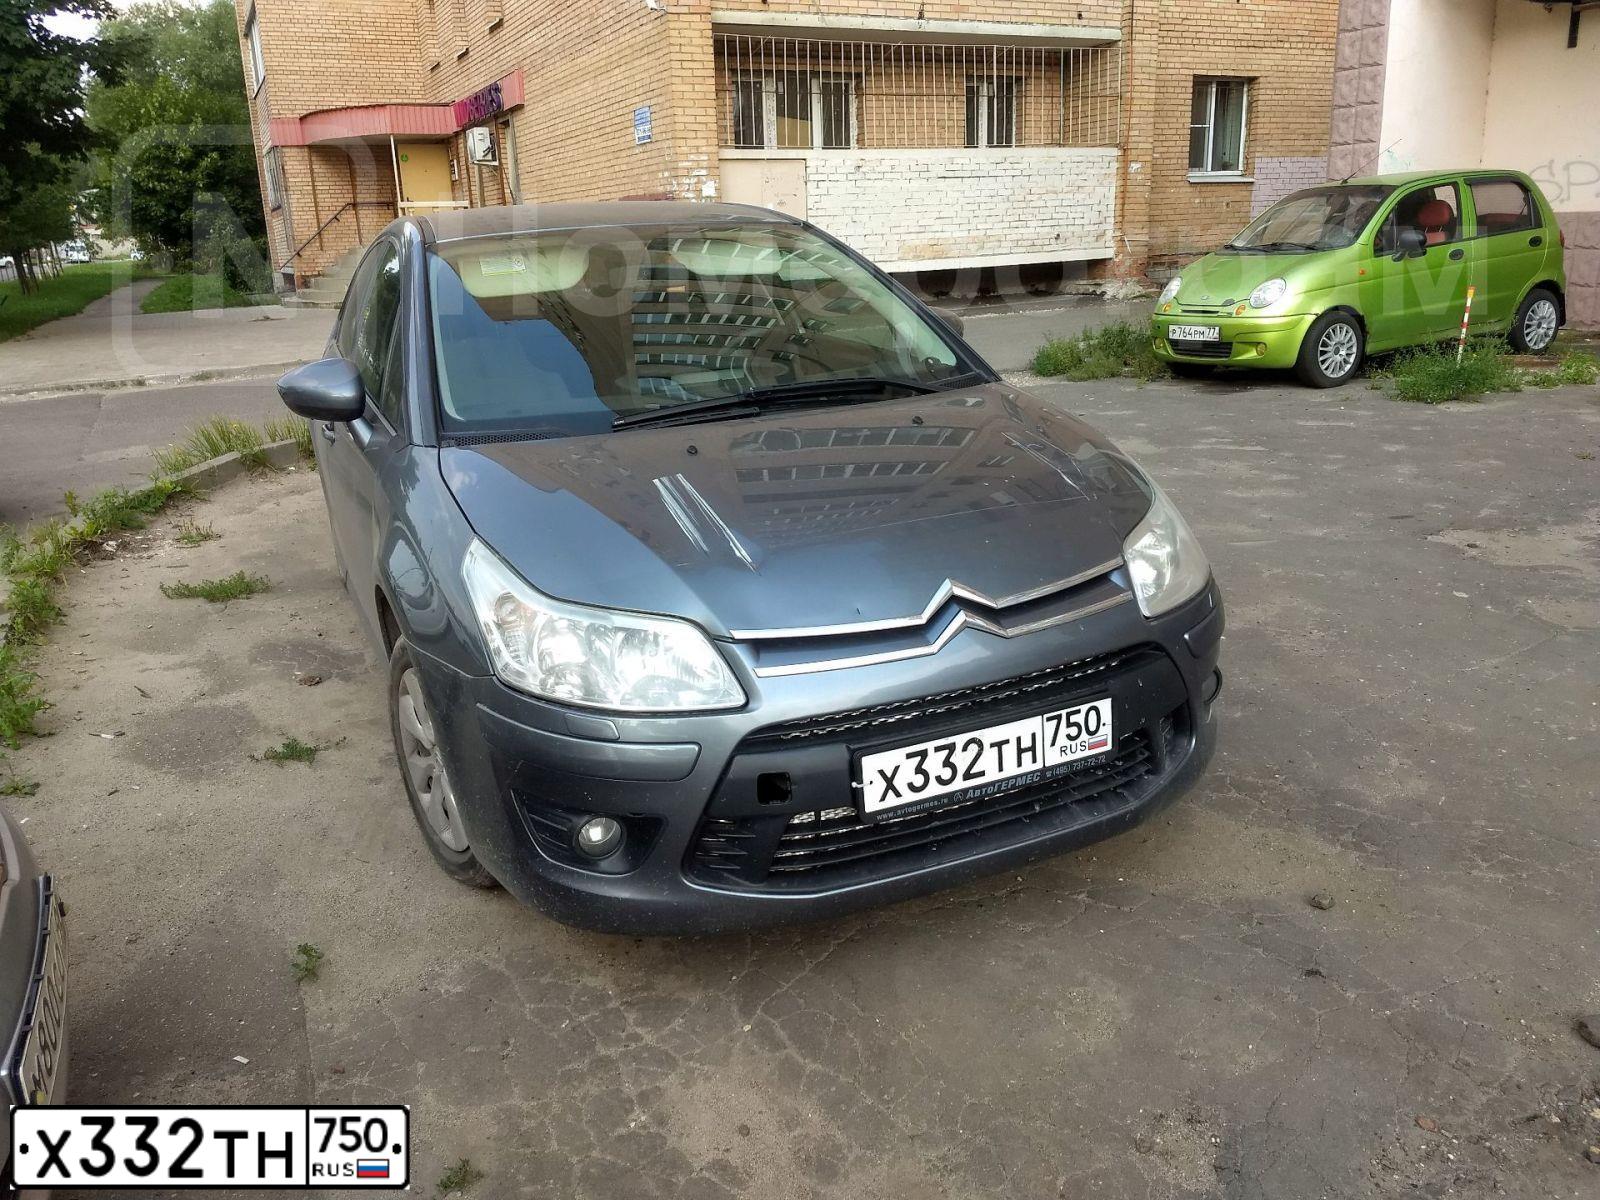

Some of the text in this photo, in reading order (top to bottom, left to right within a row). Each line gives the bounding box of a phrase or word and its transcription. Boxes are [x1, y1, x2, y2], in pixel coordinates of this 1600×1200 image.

[1207, 327, 1216, 337] 77
[877, 704, 1102, 803] Х332ТН 750
[1059, 740, 1087, 758] RUS
[876, 797, 949, 820] www.avtogermes.ru
